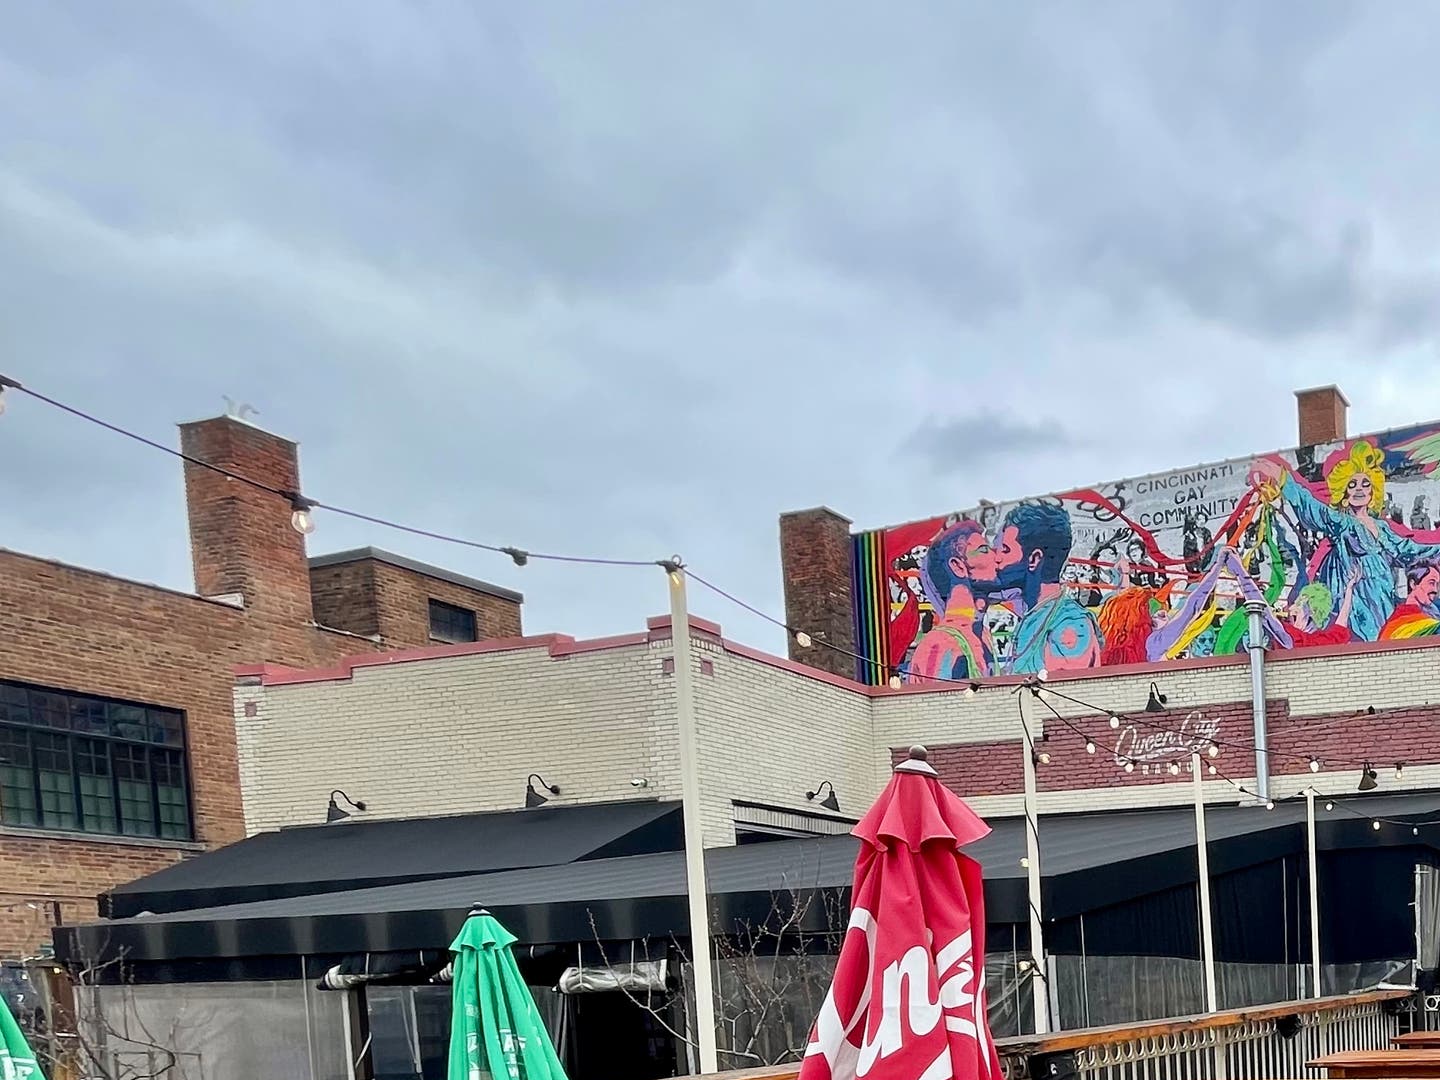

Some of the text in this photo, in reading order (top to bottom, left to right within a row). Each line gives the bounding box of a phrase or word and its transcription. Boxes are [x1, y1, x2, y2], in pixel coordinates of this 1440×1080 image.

[1136, 464, 1234, 495] CINCINNATI
[1174, 484, 1207, 505] GAY
[1139, 497, 1239, 527] COMMUNITY
[1114, 710, 1221, 766] Queen City
